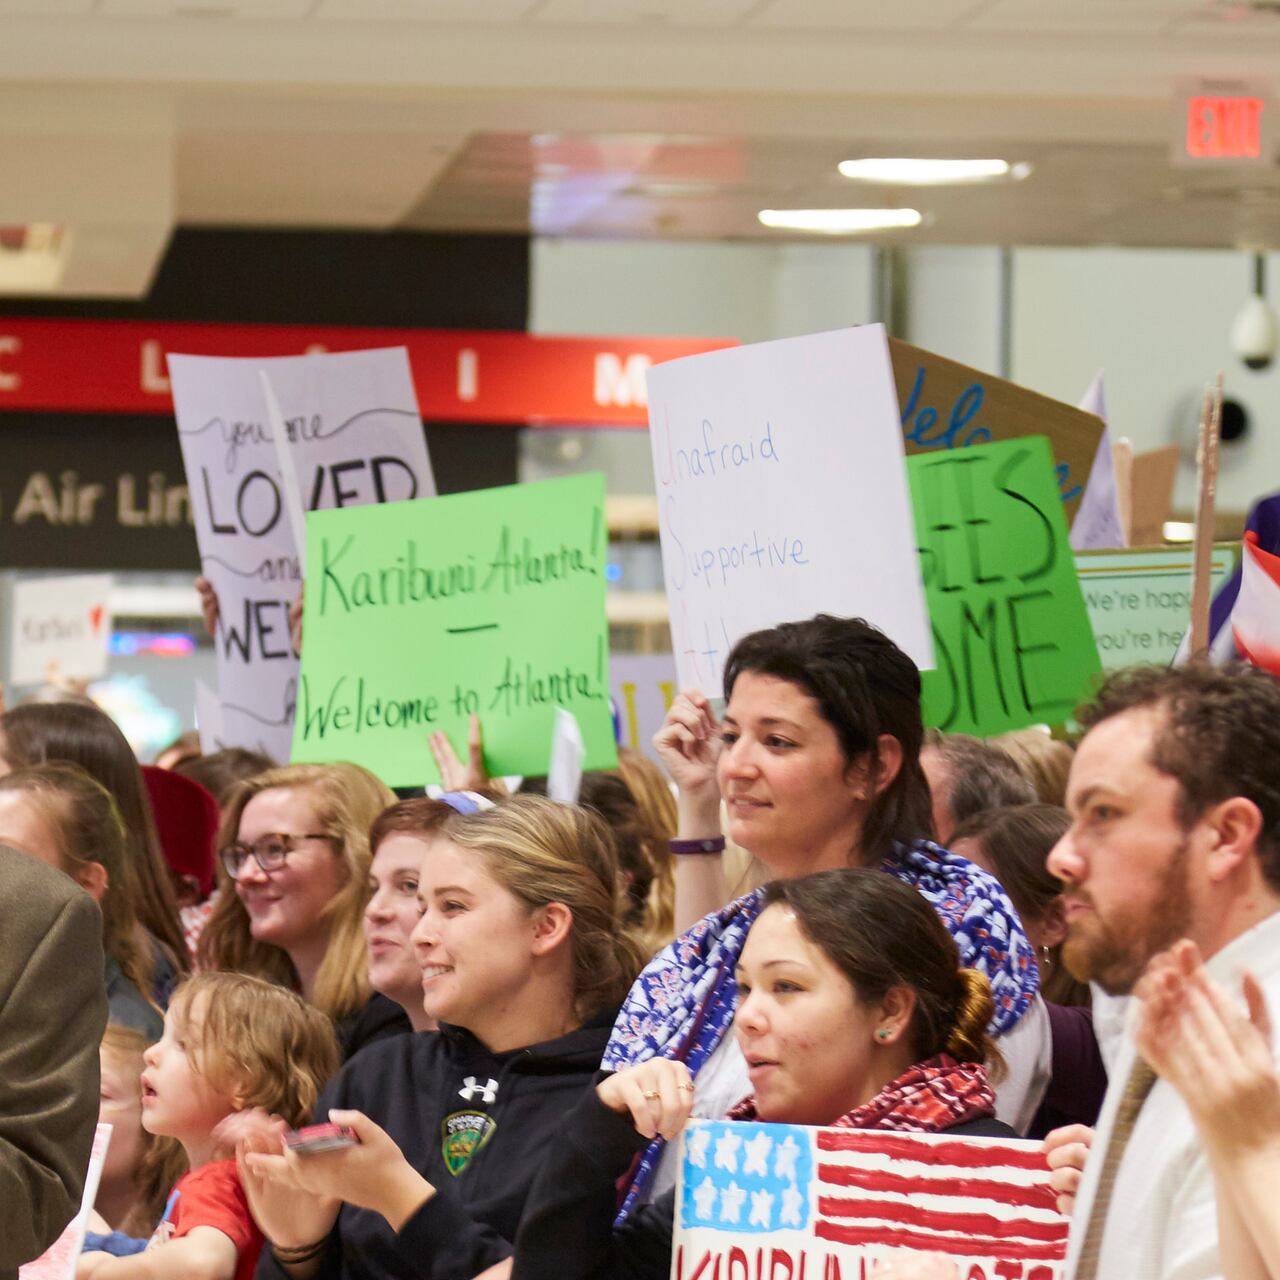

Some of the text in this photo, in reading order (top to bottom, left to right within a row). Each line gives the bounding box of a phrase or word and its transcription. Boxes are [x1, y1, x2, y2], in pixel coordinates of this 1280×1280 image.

[14, 471, 104, 526] Air
[119, 471, 194, 527] Lin
[665, 495, 810, 592] Supportive
[318, 504, 600, 617] Karibuni Atlanta!
[302, 670, 442, 741] Welcome
[453, 684, 481, 718] to
[488, 634, 604, 718] Atlanta!
